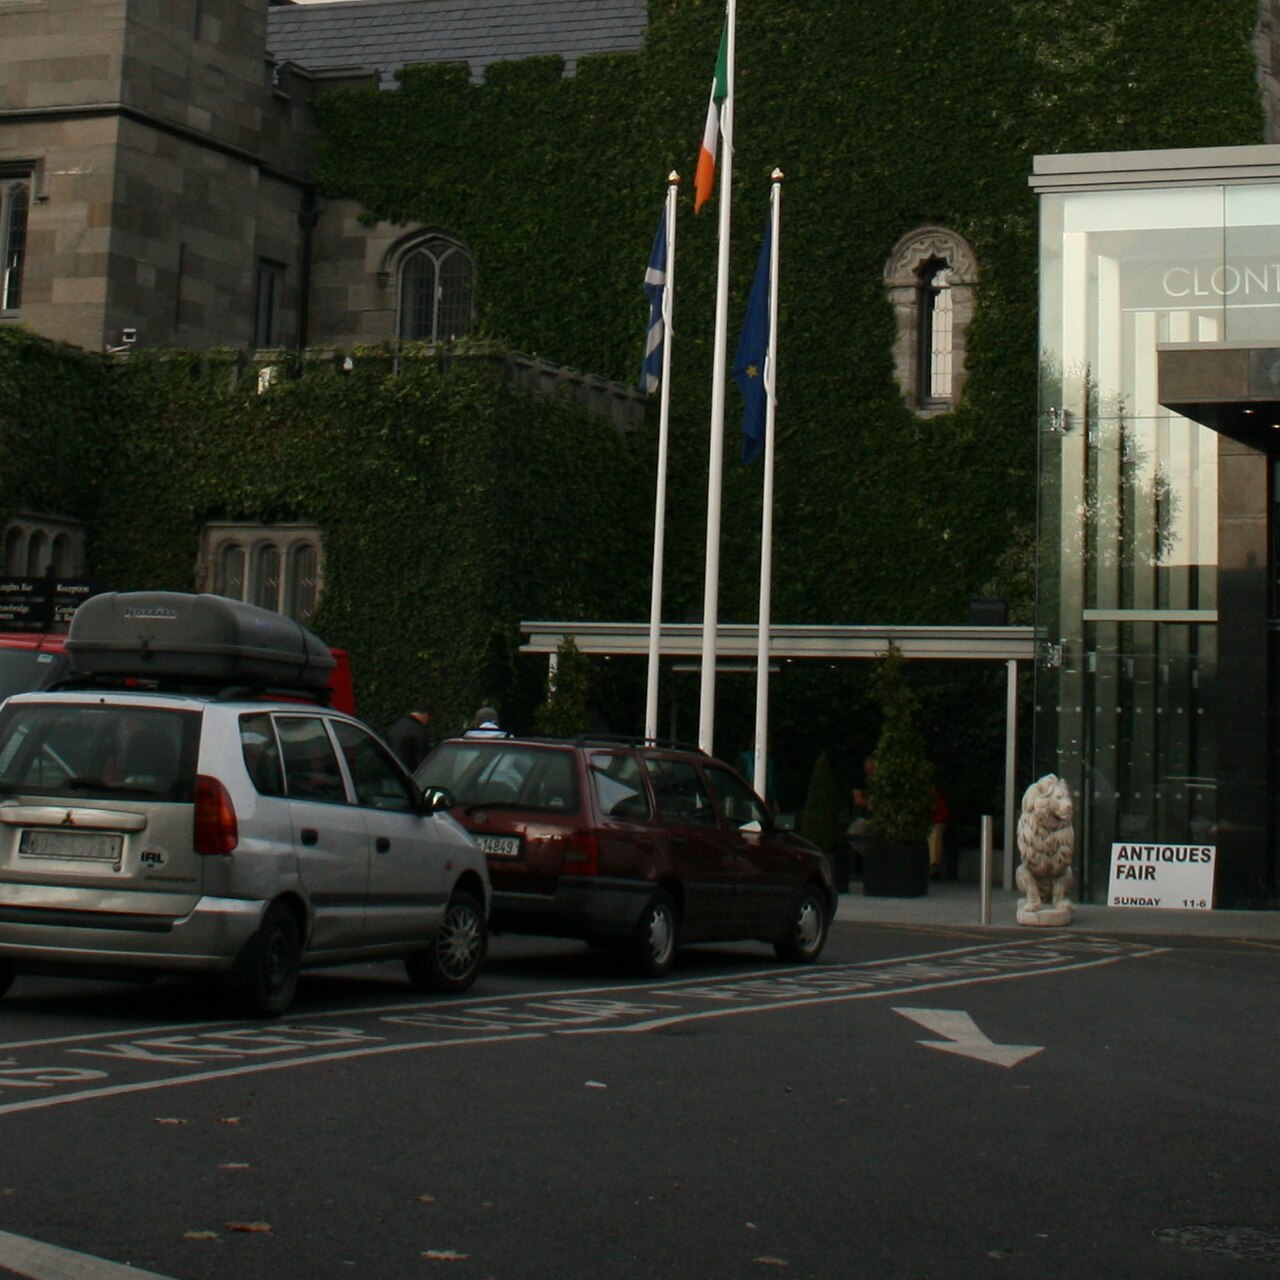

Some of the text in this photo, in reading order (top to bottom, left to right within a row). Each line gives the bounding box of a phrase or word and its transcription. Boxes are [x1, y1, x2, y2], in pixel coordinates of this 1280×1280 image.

[141, 852, 164, 863] IRL
[1117, 846, 1212, 863] ANTIQUES
[1116, 864, 1156, 880] FAIR
[1114, 897, 1207, 908] SUNDAY 11-6
[64, 1024, 386, 1065] KEEP
